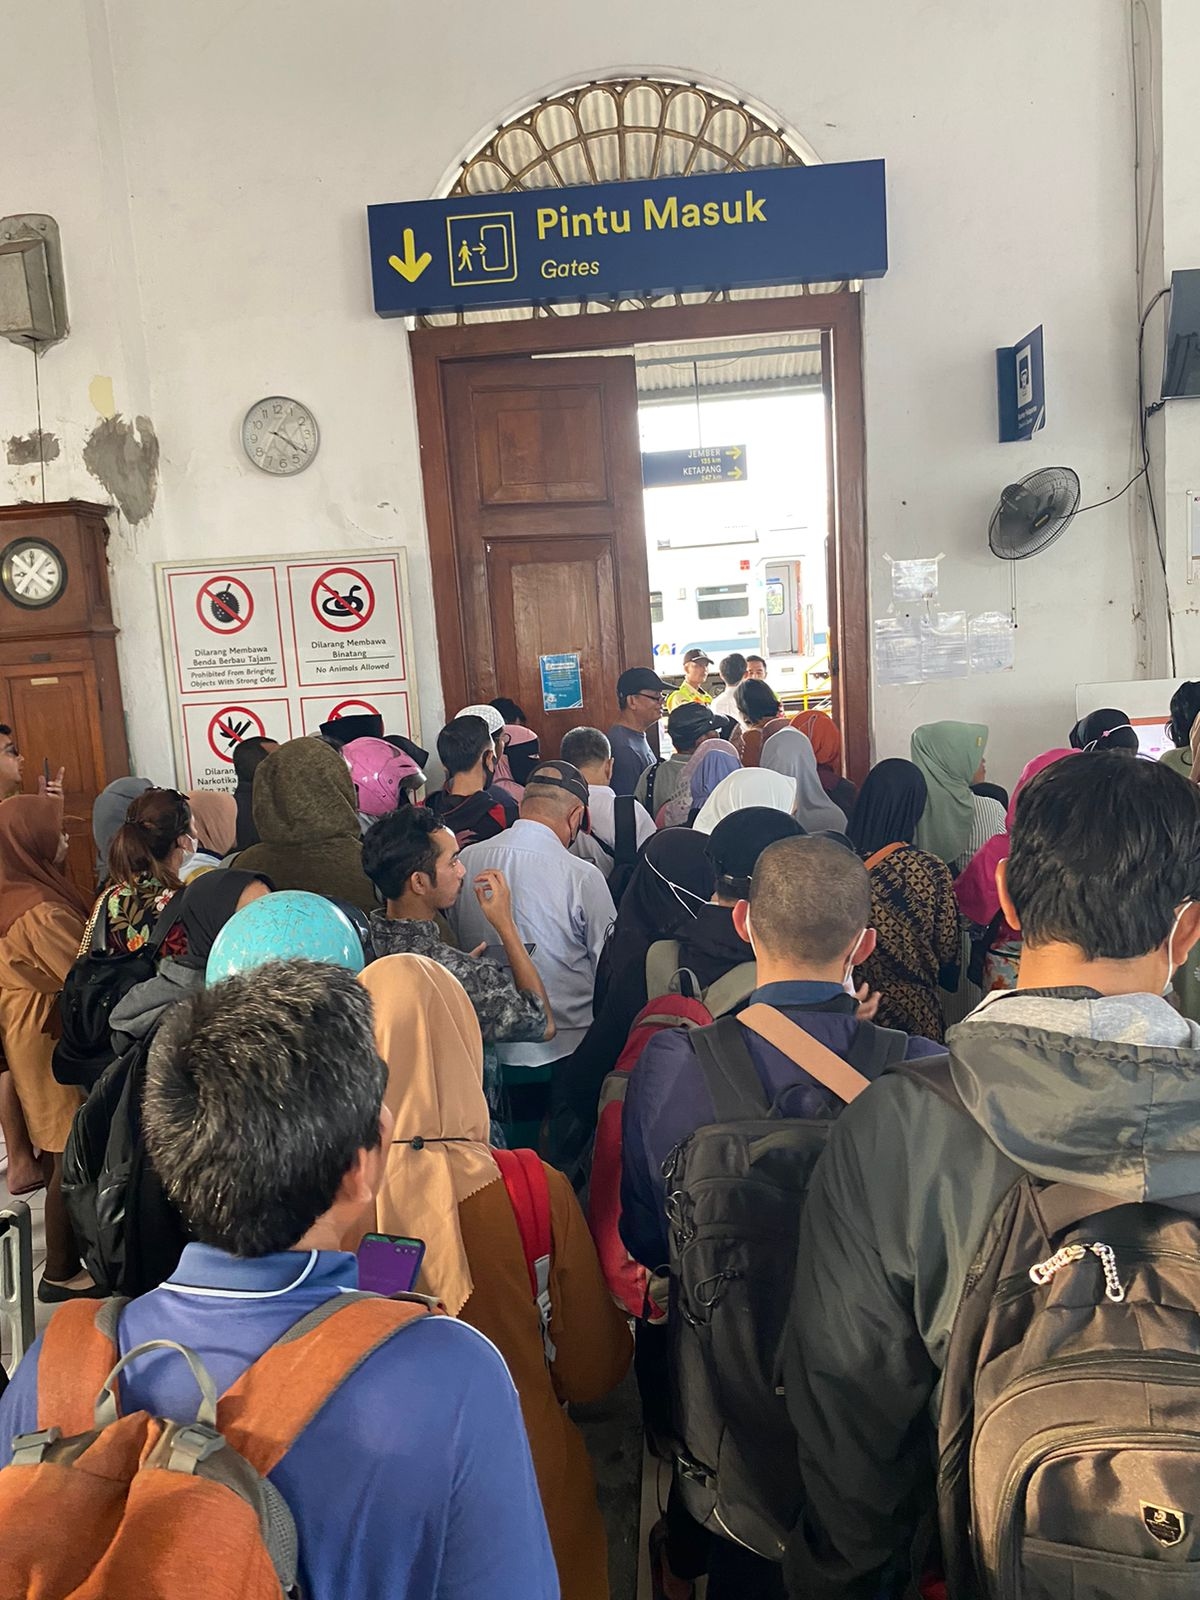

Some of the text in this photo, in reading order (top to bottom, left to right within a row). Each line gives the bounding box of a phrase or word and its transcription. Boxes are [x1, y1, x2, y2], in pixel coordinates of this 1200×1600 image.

[536, 190, 768, 240] Pintu Masuk
[540, 259, 600, 279] Gates
[688, 448, 721, 459] JEMBER
[683, 465, 721, 476] KETAPANG
[311, 638, 387, 649] Dilarang Membawa
[194, 646, 268, 657] Dilarang Membawa
[332, 650, 367, 659] Binatang
[193, 655, 271, 666] Benda Berbau Tajam
[190, 667, 275, 678] Prohibited From Bringing
[316, 666, 327, 674] No
[360, 662, 390, 671] Allowed
[190, 680, 216, 688] Objects
[217, 678, 235, 686] With
[236, 677, 258, 685] Strong
[197, 777, 236, 785] Narkotika
